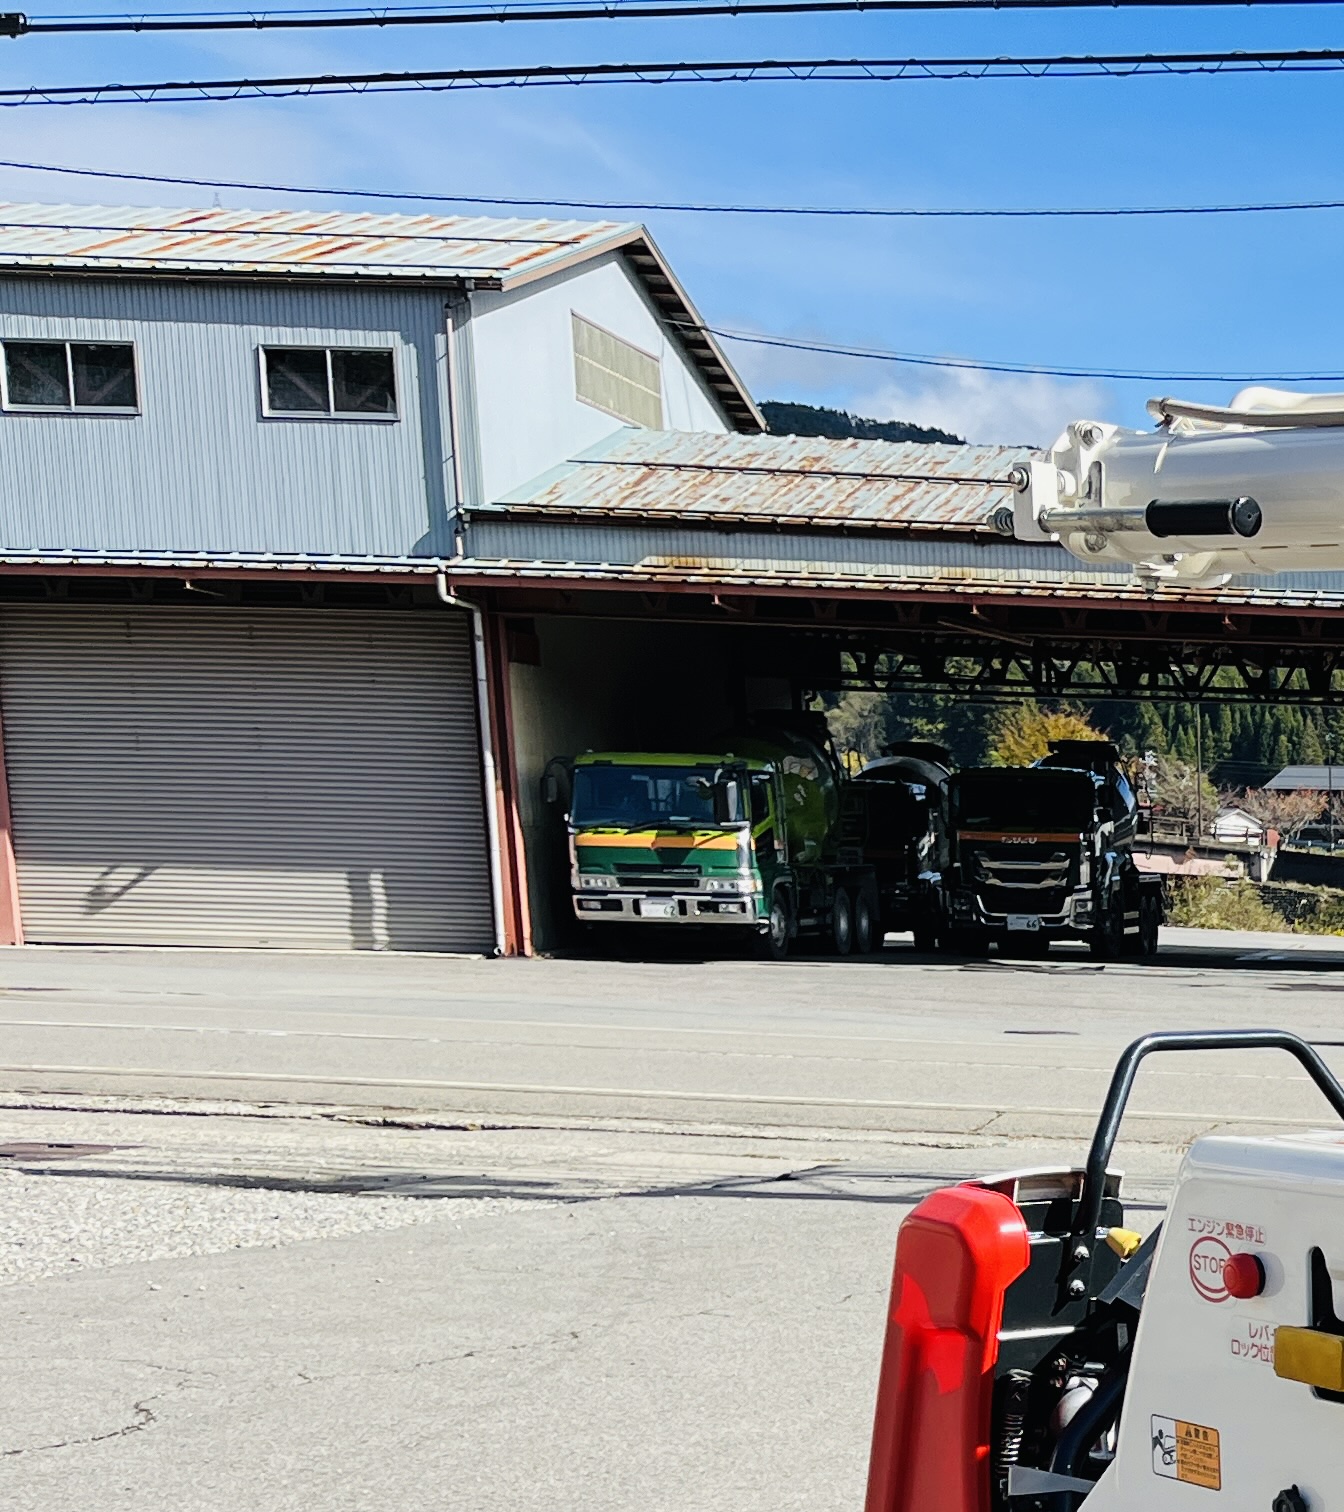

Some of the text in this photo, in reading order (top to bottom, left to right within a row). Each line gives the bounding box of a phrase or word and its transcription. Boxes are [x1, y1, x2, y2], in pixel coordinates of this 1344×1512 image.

[1187, 1218, 1264, 1244] エンジン緊急停止
